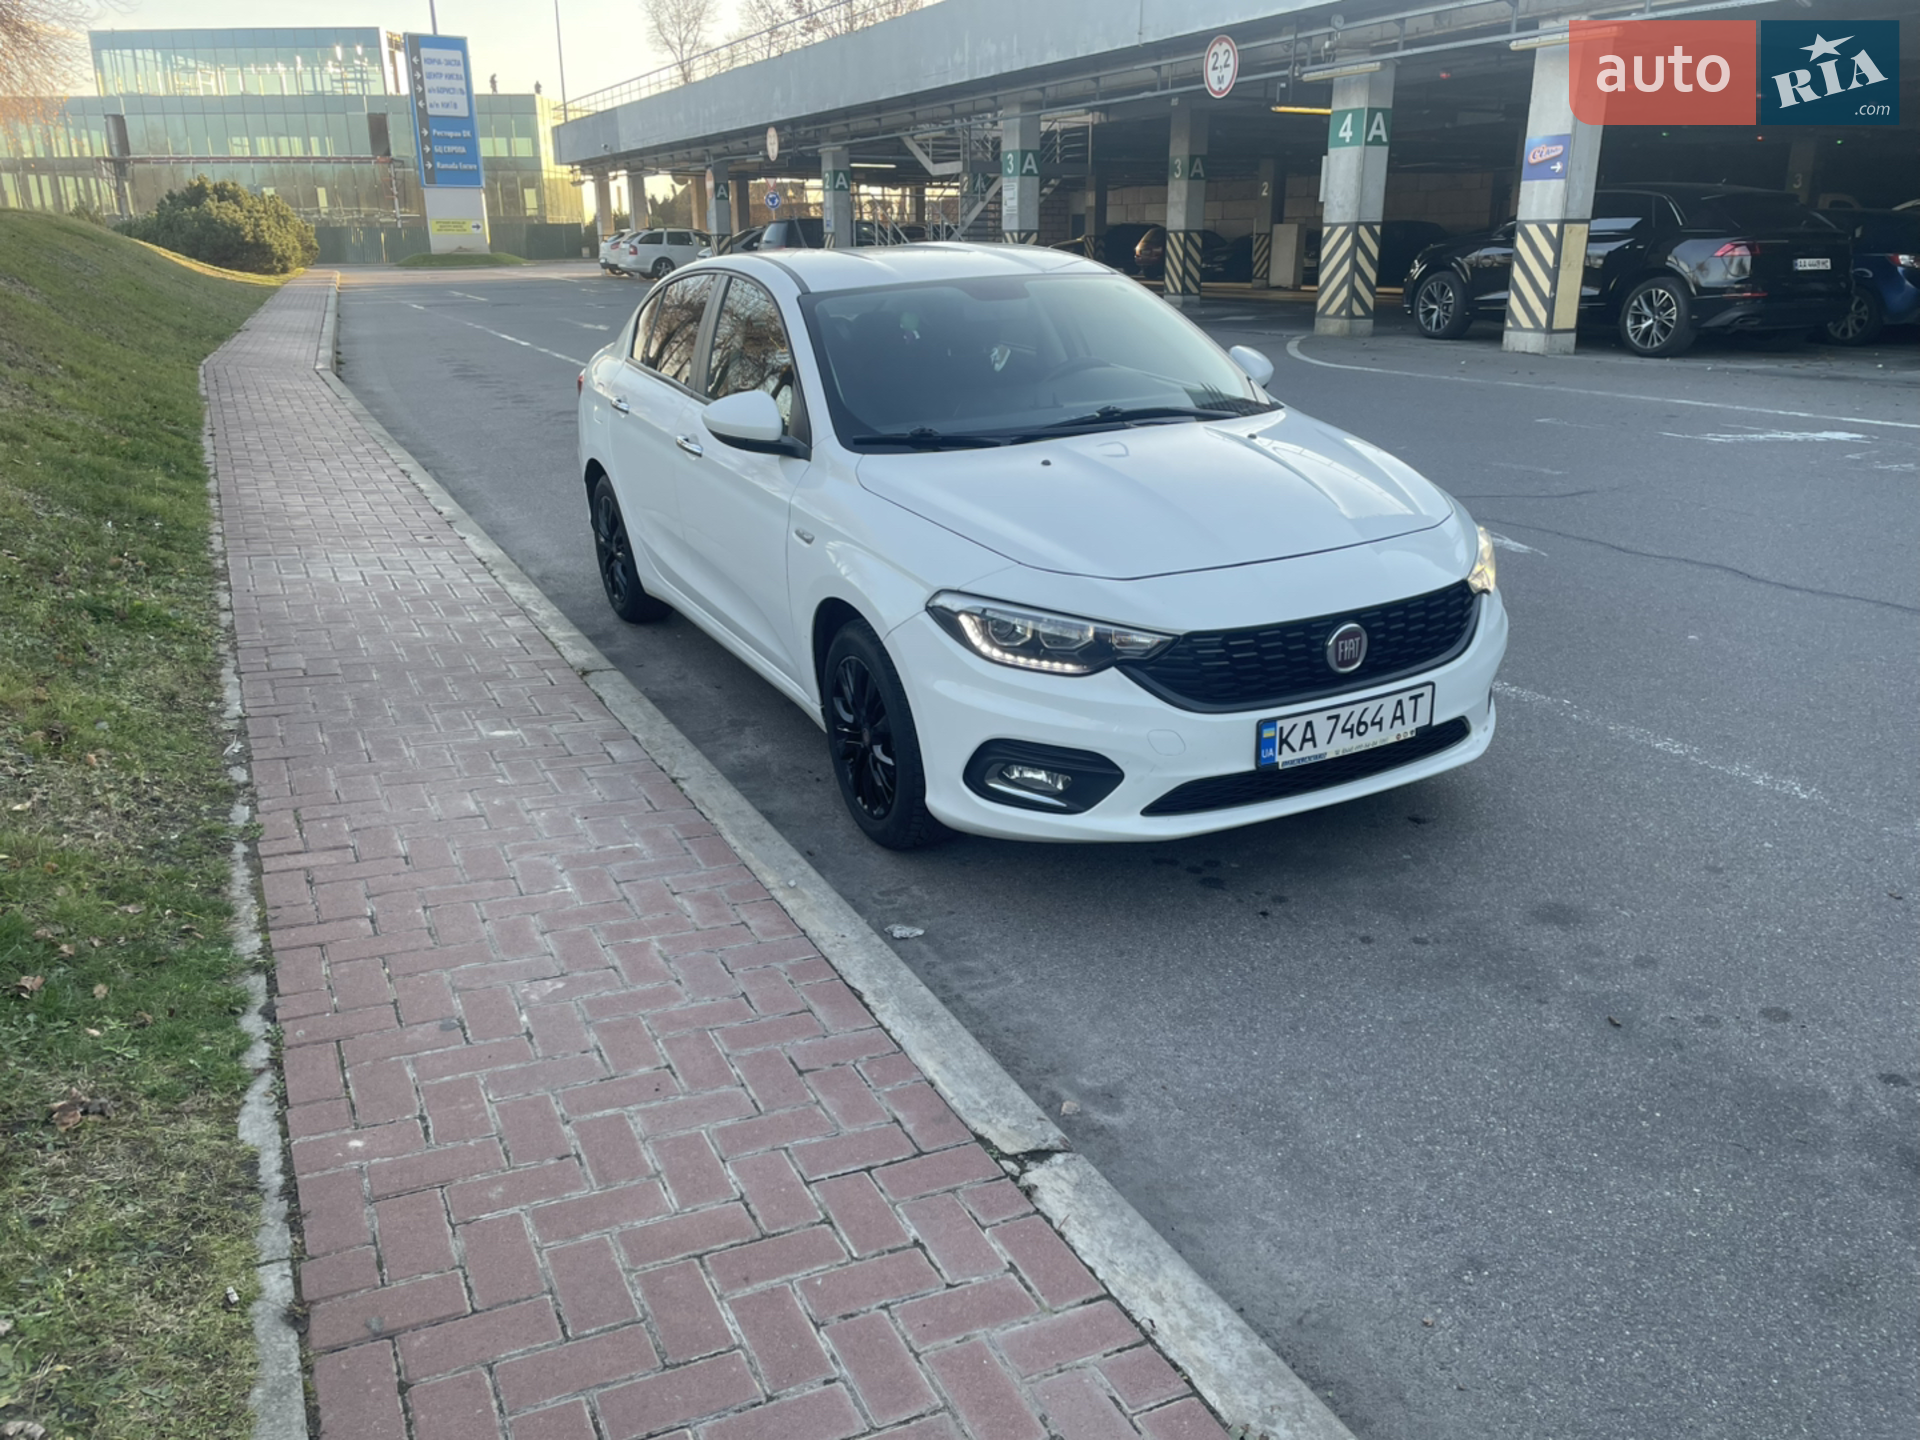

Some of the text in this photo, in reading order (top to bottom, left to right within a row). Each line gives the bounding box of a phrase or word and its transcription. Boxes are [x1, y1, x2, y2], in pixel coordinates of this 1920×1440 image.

[1211, 49, 1231, 73] 2,2
[1338, 112, 1353, 143] 4
[1006, 153, 1014, 174] 3
[1338, 636, 1361, 662] FIAT
[1278, 720, 1317, 756] KA
[1326, 703, 1384, 745] 7464
[1389, 692, 1425, 730] AT
[1261, 747, 1275, 758] UA
